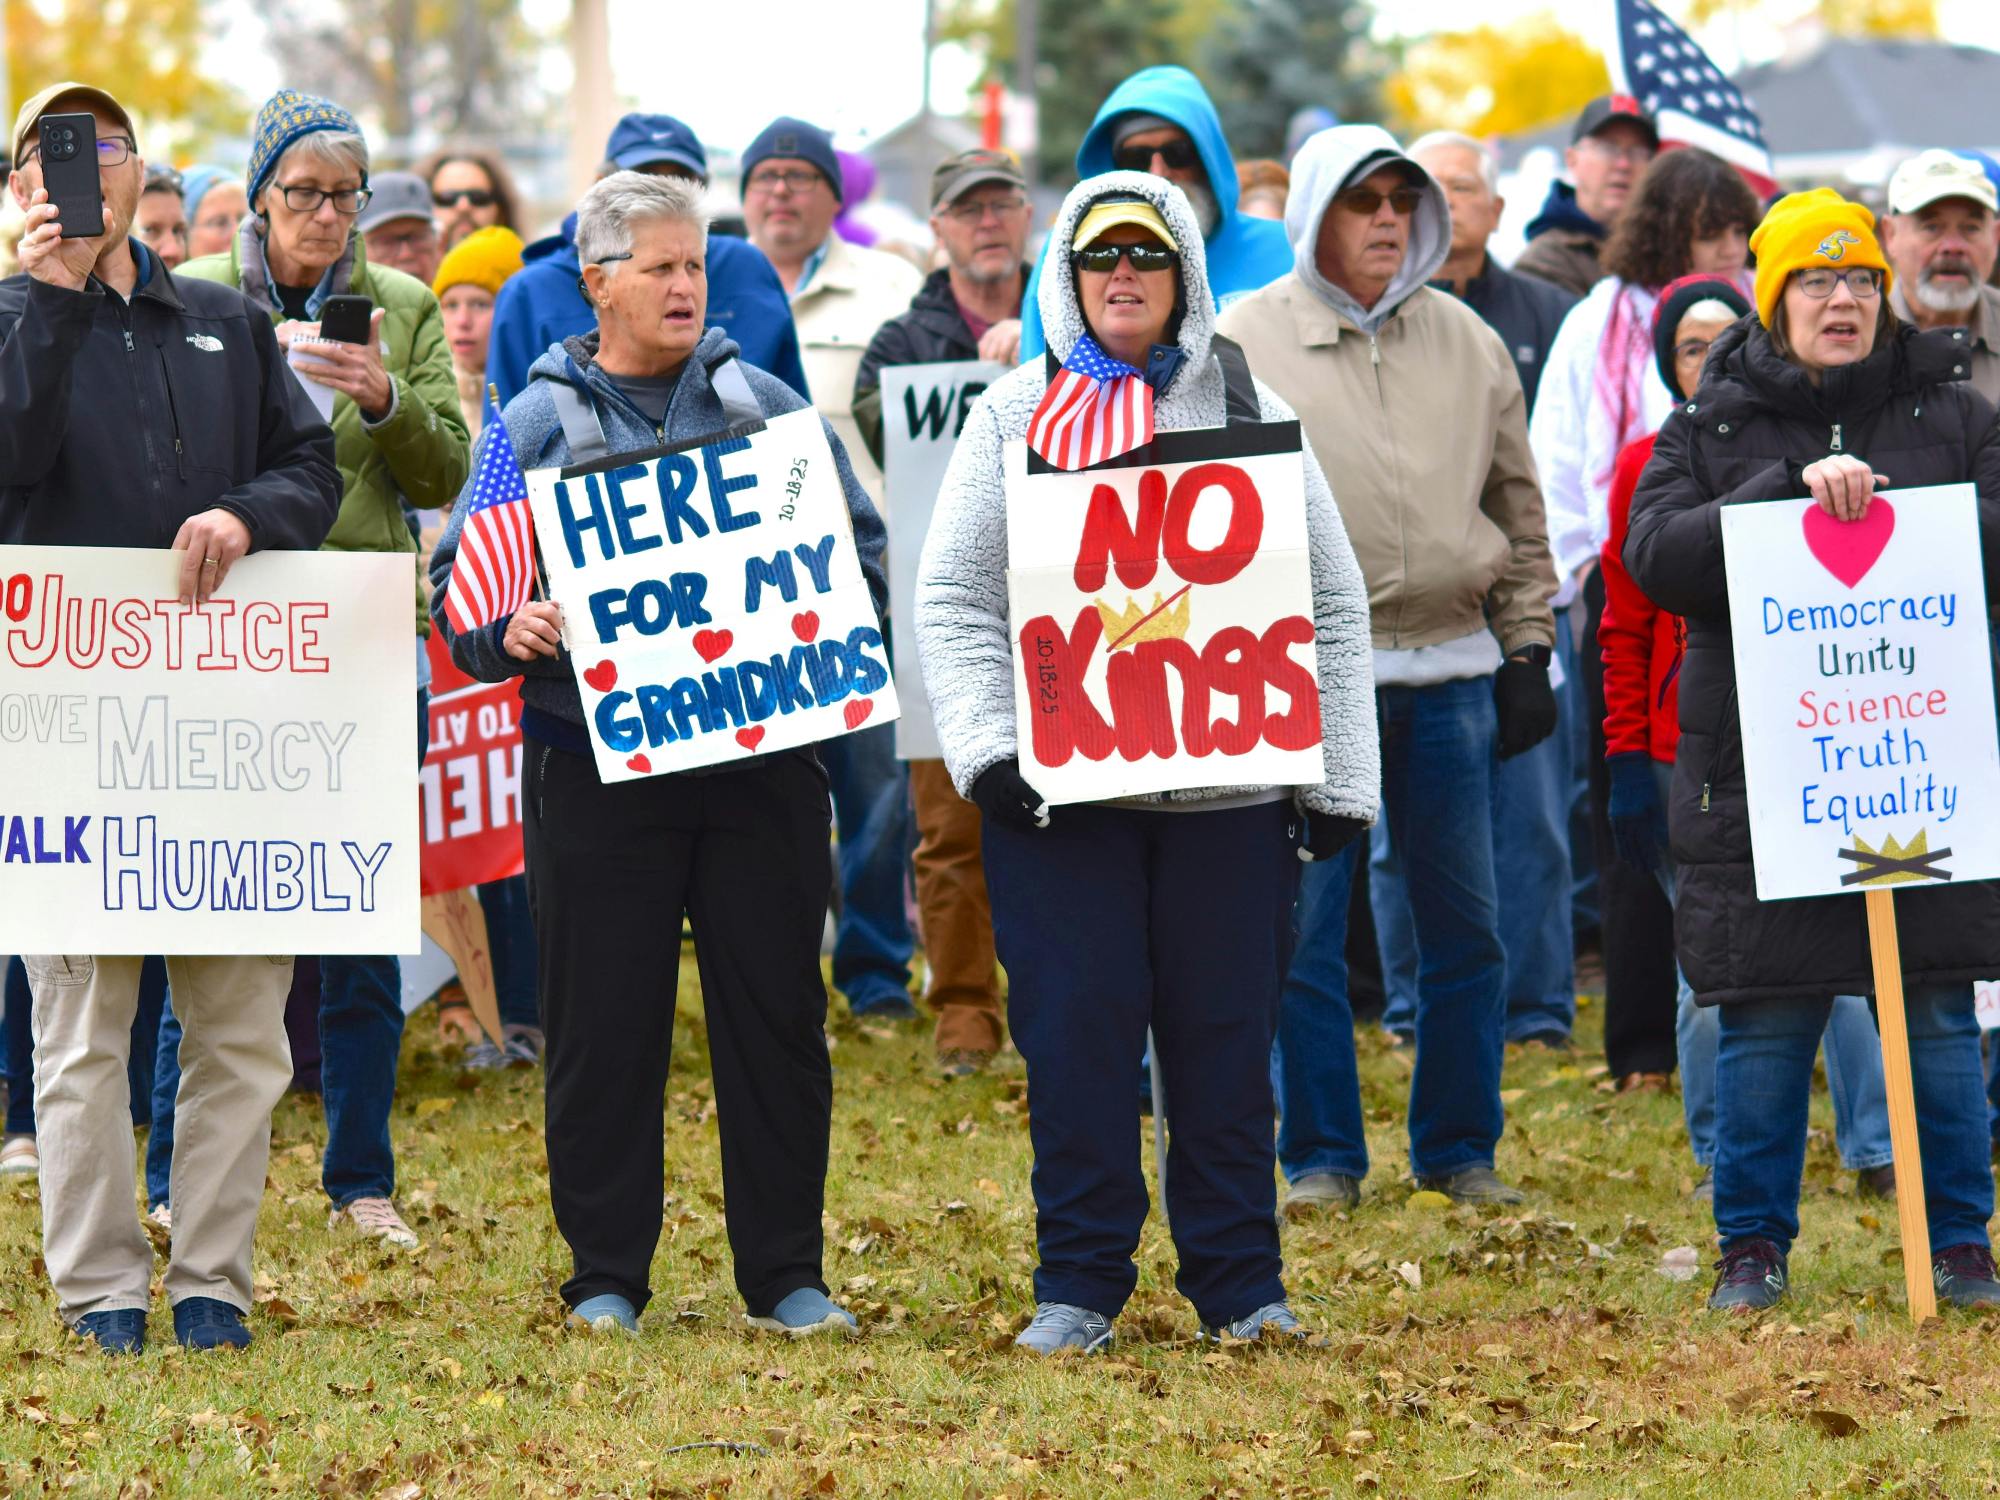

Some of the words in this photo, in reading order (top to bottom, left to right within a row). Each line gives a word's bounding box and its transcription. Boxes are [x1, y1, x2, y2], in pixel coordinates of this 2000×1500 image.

[555, 436, 761, 568] HERE
[1073, 463, 1264, 593] NO
[8, 574, 329, 672] JUSTICE
[589, 572, 712, 644] FOR
[745, 534, 835, 613] MY
[1763, 593, 1957, 635] Democracy
[594, 626, 888, 752] GRANDKIDS
[1818, 637, 1915, 677] Unity
[98, 694, 357, 791] MERCY
[477, 700, 516, 740] TO
[1797, 688, 1947, 728] Science
[1813, 727, 1928, 772] Truth
[1803, 773, 1958, 836] Equality
[102, 815, 393, 912] HUMBLY
